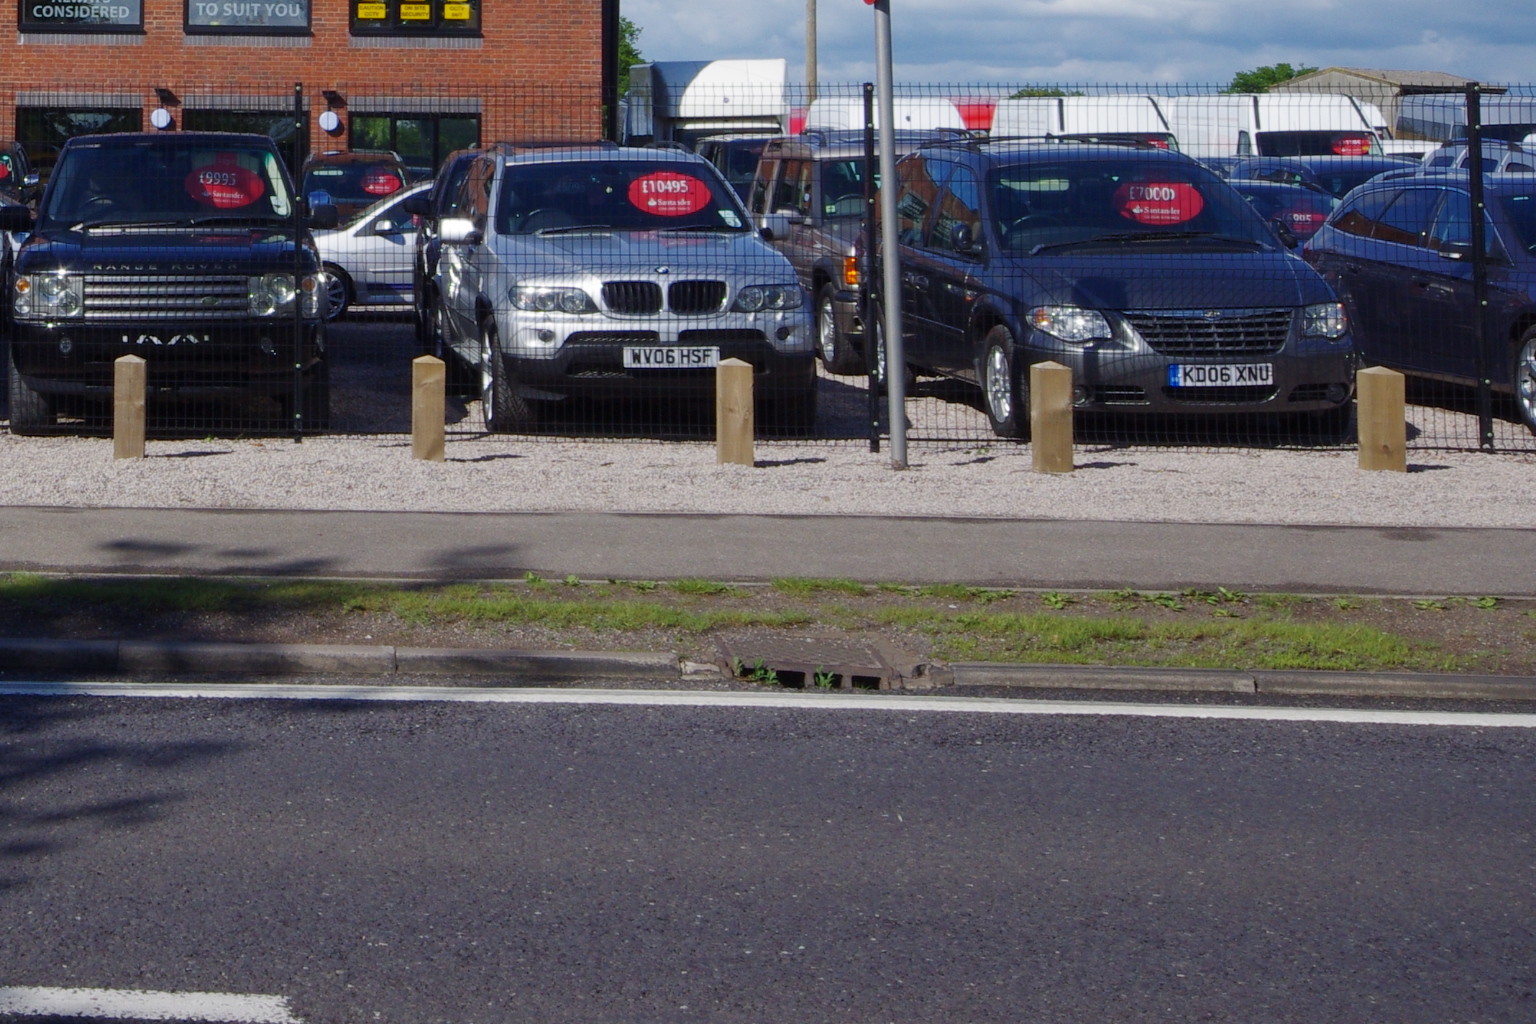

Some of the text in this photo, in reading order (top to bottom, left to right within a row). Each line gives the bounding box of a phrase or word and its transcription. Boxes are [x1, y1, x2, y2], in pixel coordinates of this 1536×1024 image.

[33, 5, 130, 18] CONSIDERED
[196, 3, 300, 17] TO SUIT YOU
[641, 180, 689, 193] £10495
[213, 190, 244, 199] Santander
[658, 198, 691, 206] Santander
[1144, 206, 1181, 215] Santander
[680, 349, 712, 364] HSF
[1184, 366, 1269, 382] KD06 XNU
